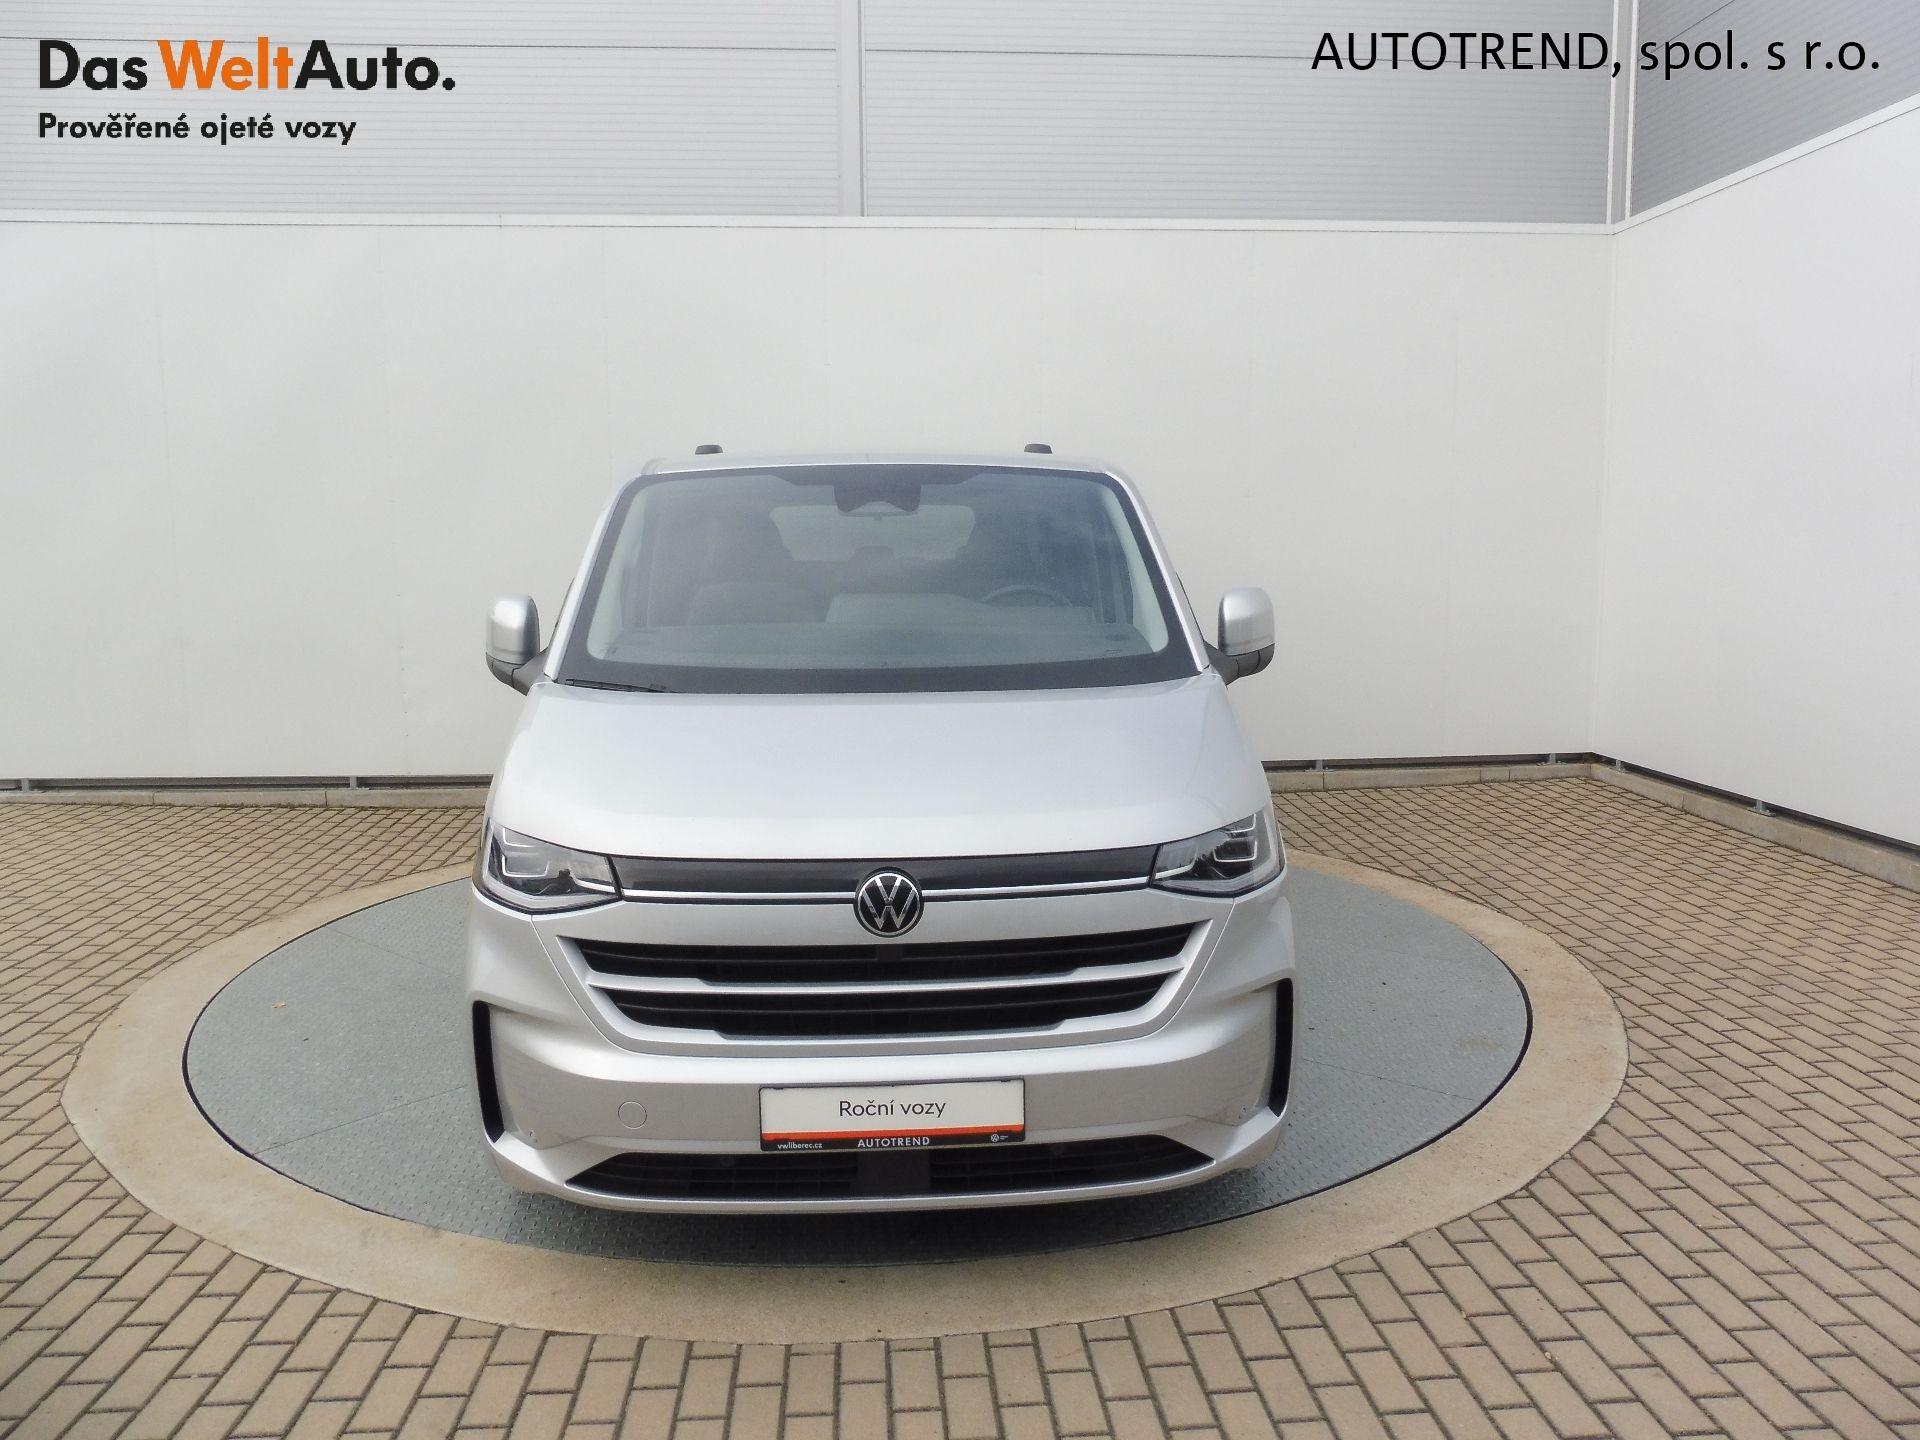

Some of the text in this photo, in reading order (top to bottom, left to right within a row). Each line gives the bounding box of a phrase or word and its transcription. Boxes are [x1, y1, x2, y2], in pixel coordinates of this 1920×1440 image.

[839, 1099, 947, 1119] Roční vozy
[777, 1141, 823, 1150] vwliberec.cz
[857, 1136, 930, 1148] AUTOTREND
